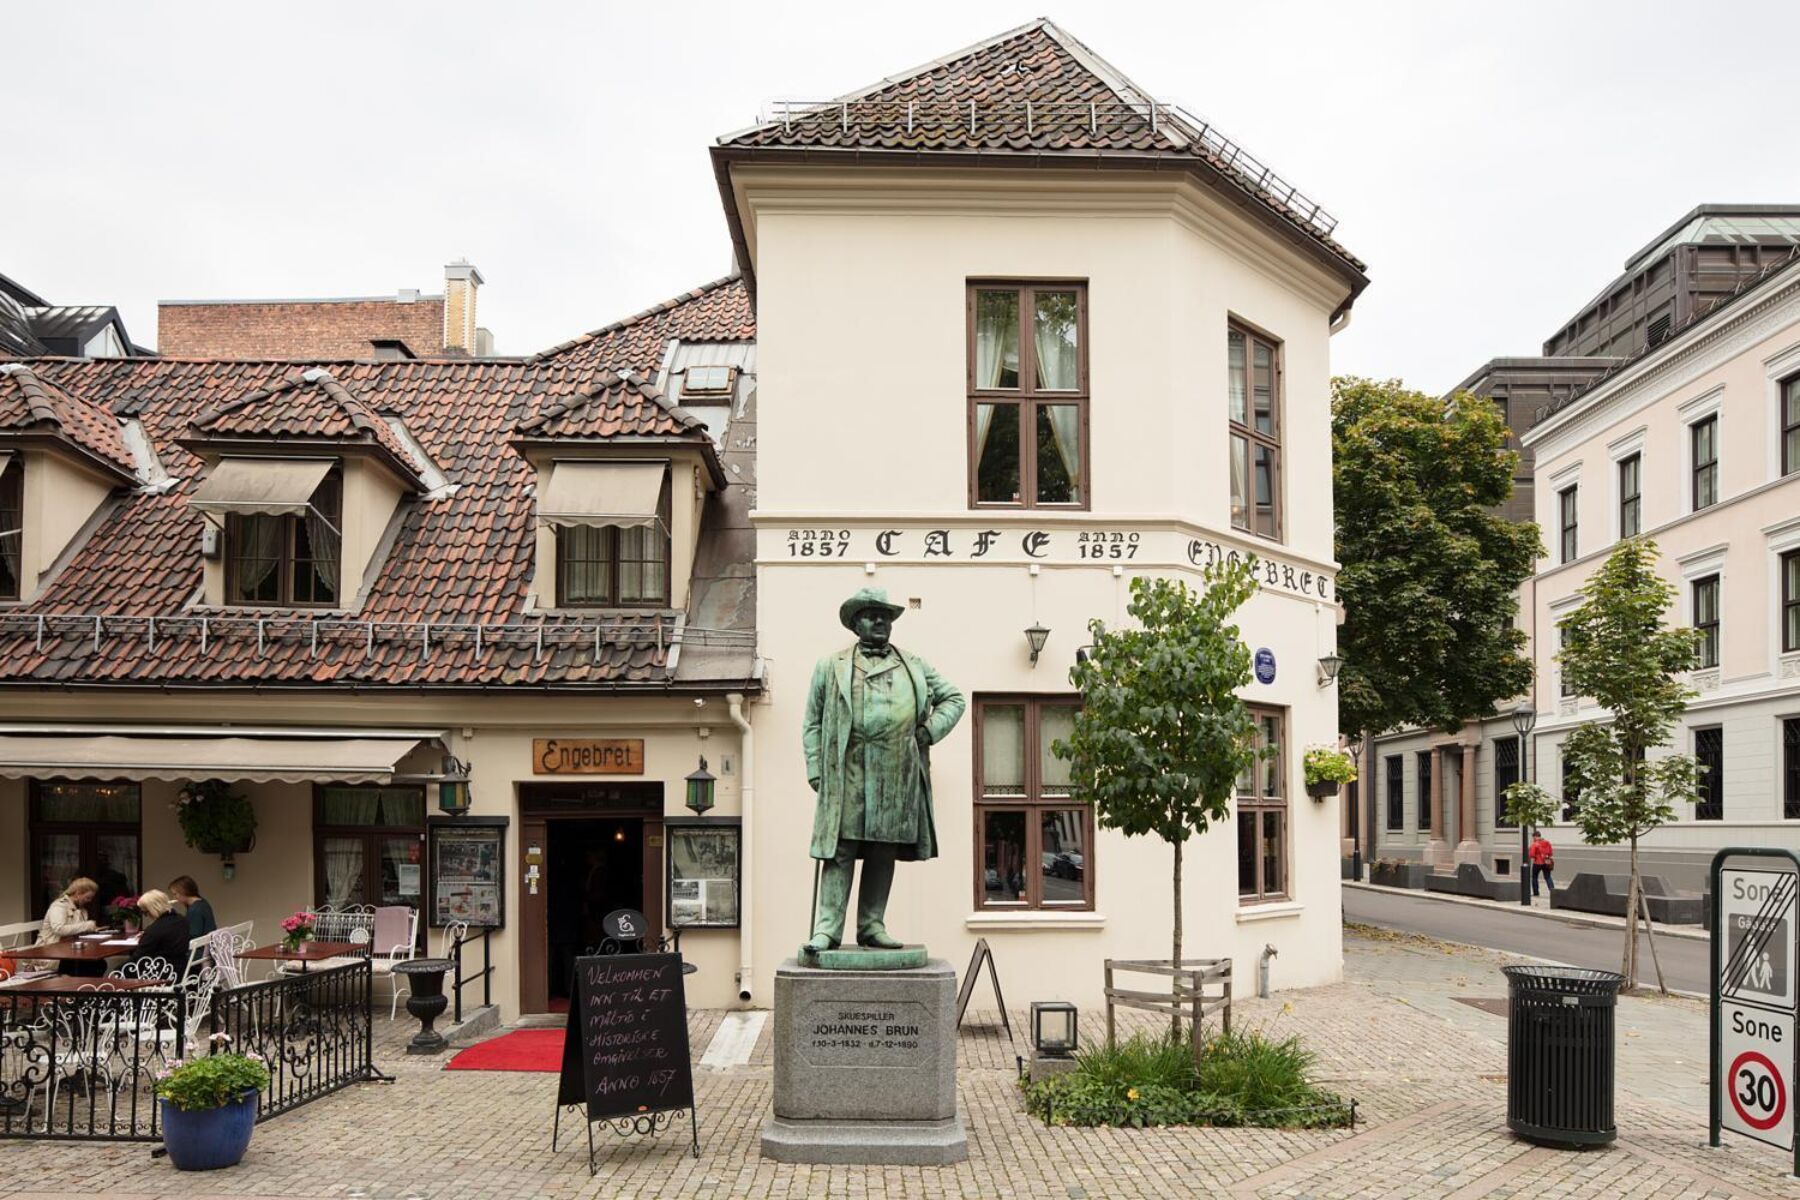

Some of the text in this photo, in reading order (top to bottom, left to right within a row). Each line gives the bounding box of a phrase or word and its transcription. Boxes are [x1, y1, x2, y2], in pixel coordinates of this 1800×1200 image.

[788, 541, 849, 557] 1857
[875, 529, 1050, 559] CAFE
[1079, 544, 1138, 559] 1857
[1187, 540, 1328, 598] ENGEBRET
[542, 740, 632, 771] Engebret
[1733, 877, 1783, 903] Sone
[588, 965, 669, 985] VELKOMMEN
[649, 989, 672, 1001] ET
[813, 1024, 919, 1036] JOHANNES BRUN
[1732, 1010, 1782, 1042] Sone
[595, 1076, 639, 1095] ANNO
[1739, 1069, 1776, 1112] 30
